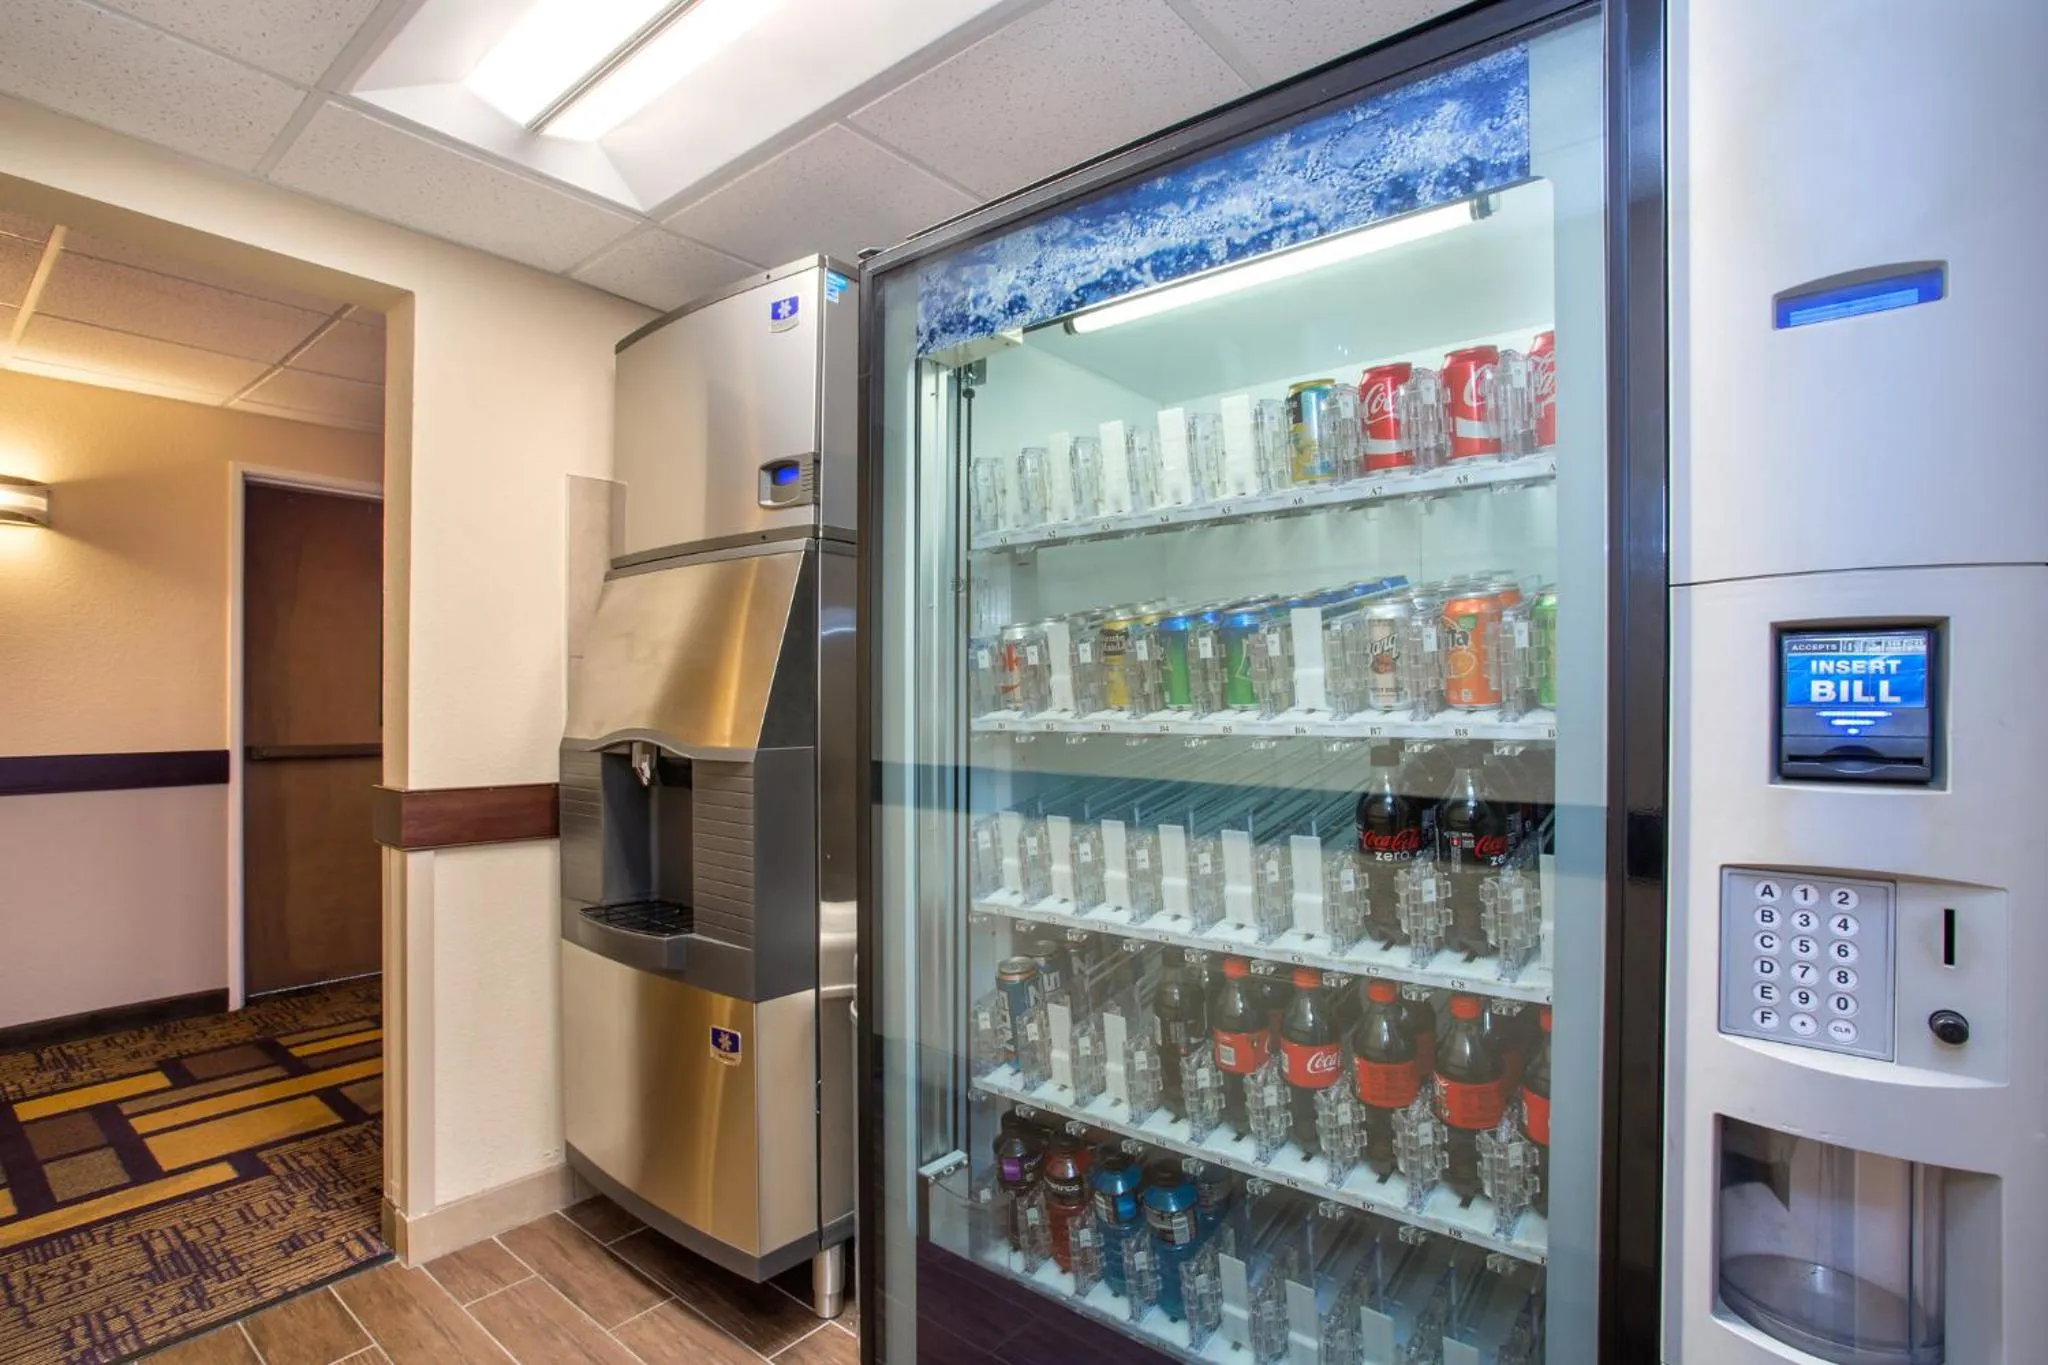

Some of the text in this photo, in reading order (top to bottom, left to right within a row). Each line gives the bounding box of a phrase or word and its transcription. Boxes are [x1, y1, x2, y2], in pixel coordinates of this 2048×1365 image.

[1791, 643, 1837, 651] ACCEPTS
[1811, 659, 1902, 675] INSERT
[1811, 680, 1902, 703] BILL
[1375, 850, 1410, 863] zero
[1761, 884, 1850, 906] A 1 2
[1760, 909, 1849, 931] B 3 4
[1760, 935, 1849, 958] C 5 6
[1760, 960, 1849, 984] D 7 8
[1760, 985, 1849, 1011] E 9 0
[1760, 1011, 1851, 1034] F CLR
